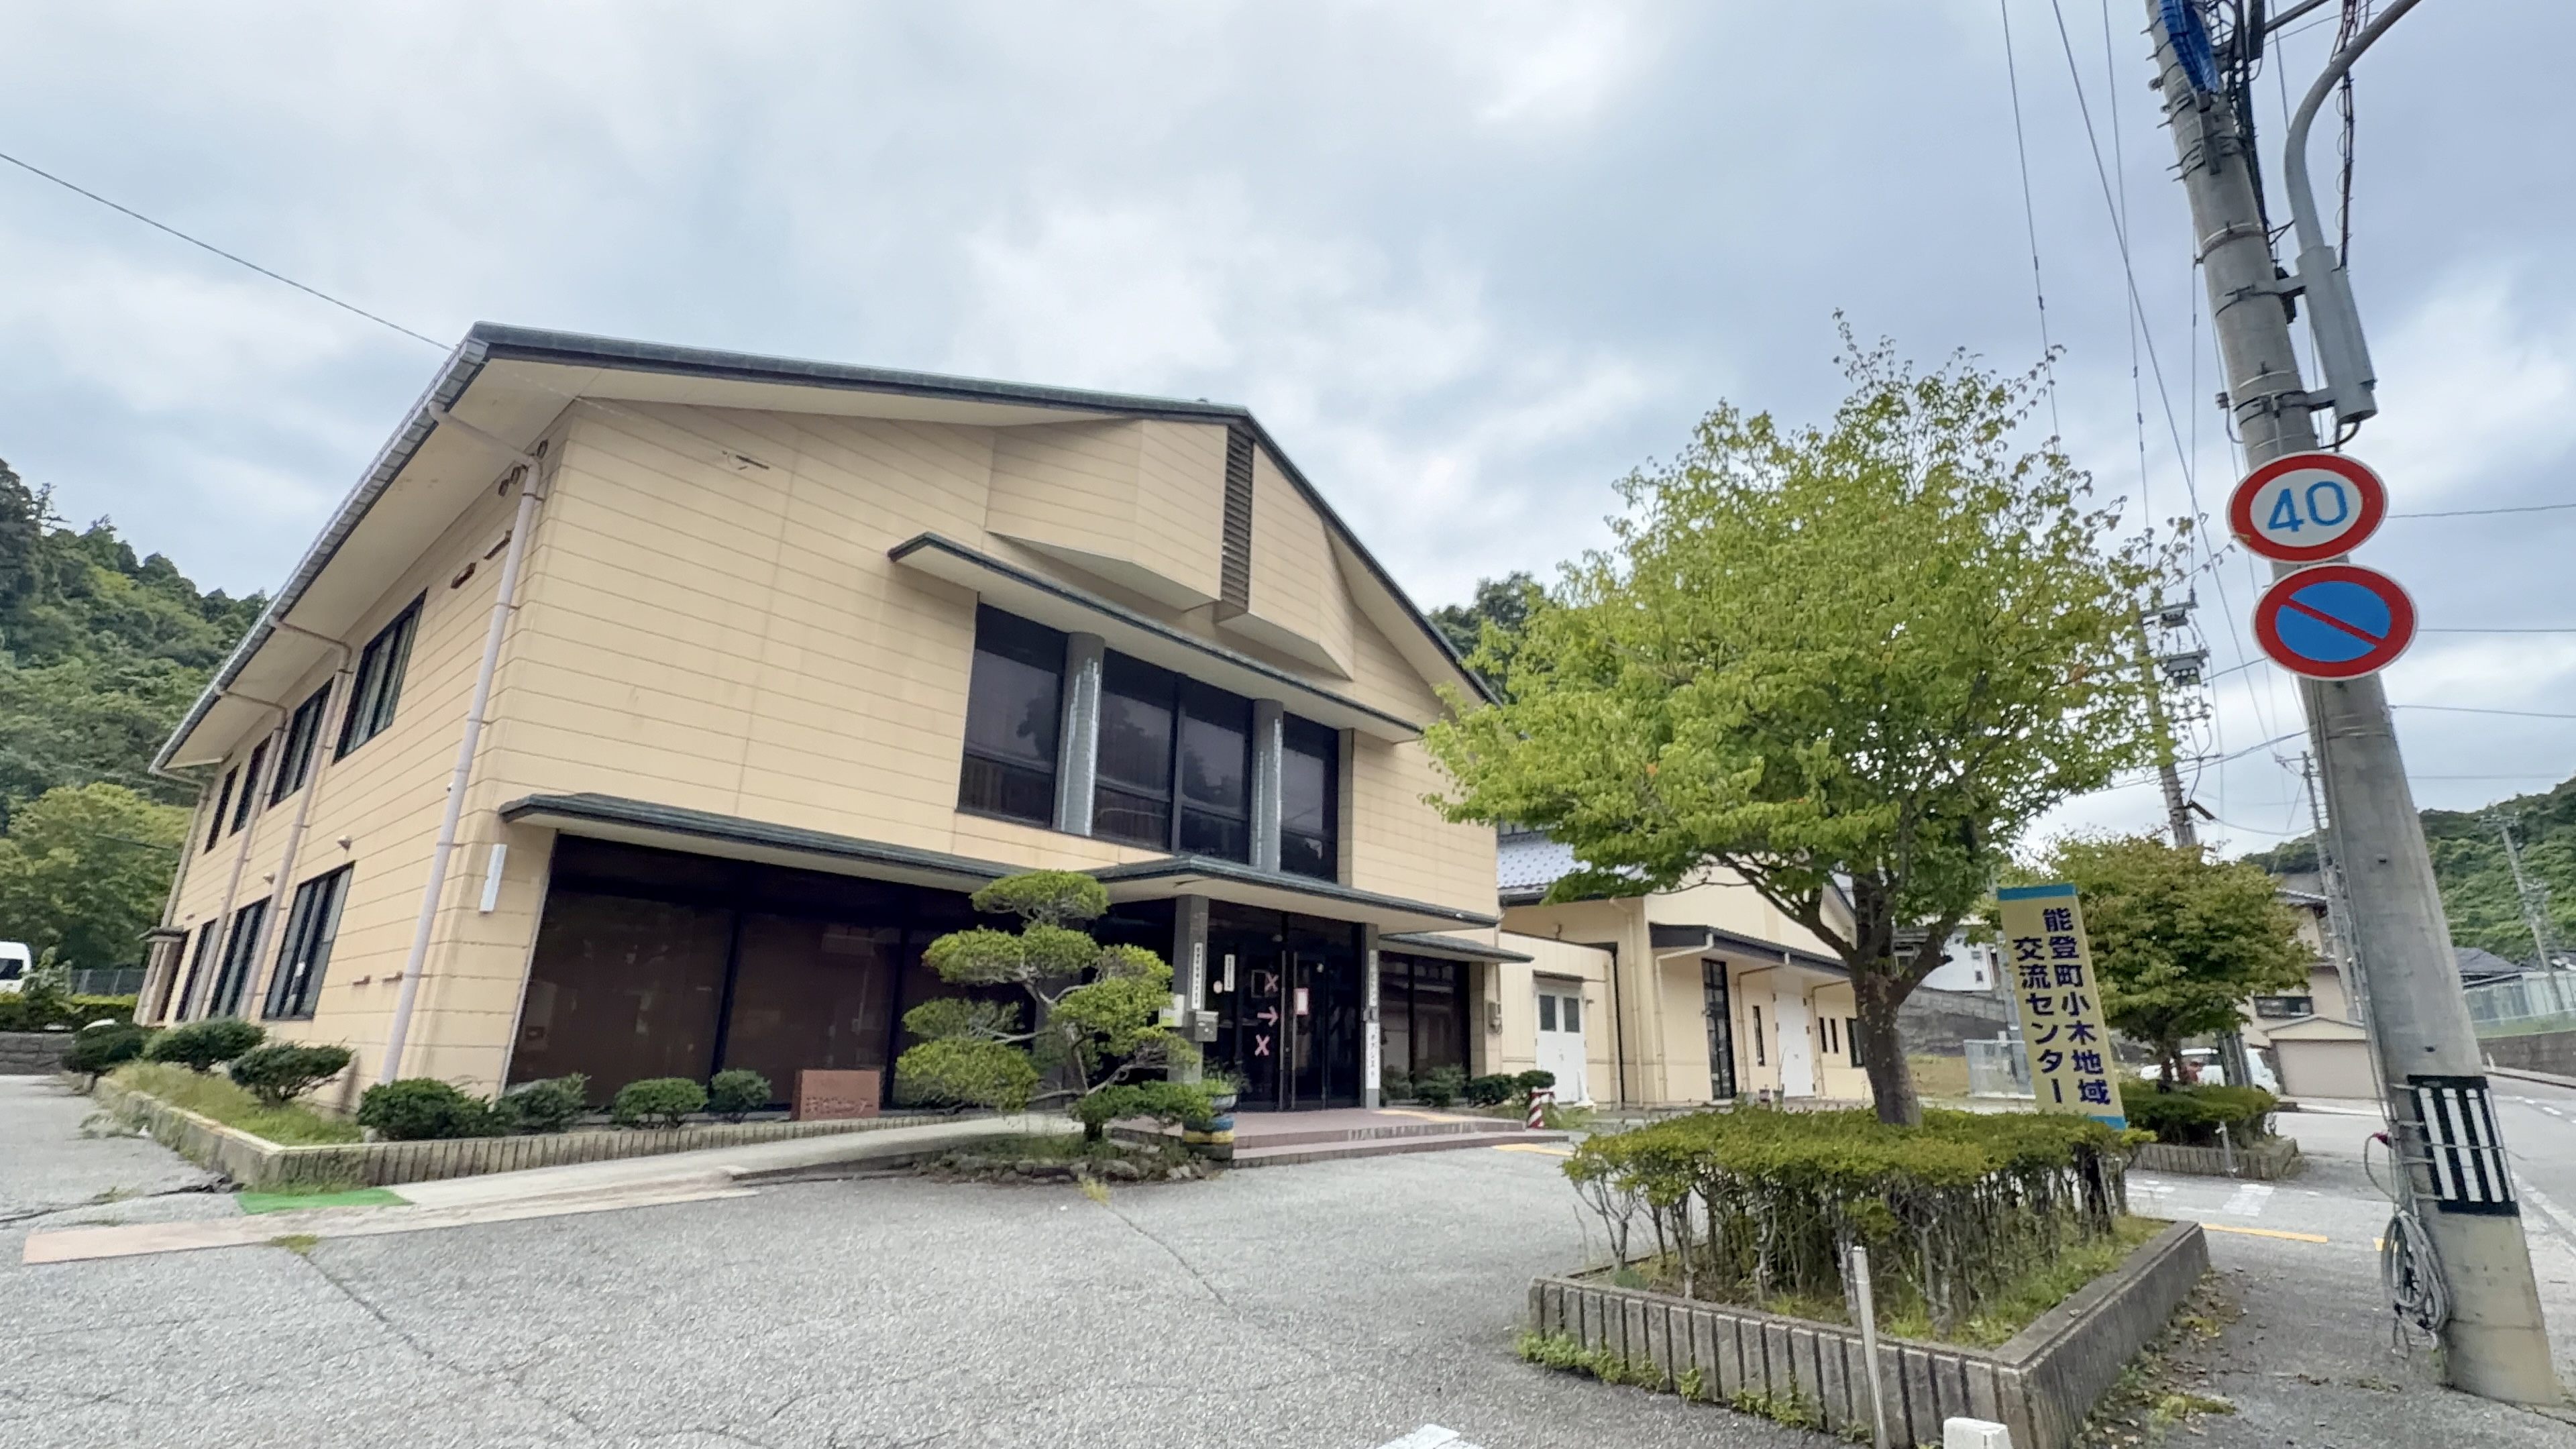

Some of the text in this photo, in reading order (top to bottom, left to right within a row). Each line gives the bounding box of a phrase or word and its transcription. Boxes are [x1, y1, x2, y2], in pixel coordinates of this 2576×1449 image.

[2267, 481, 2349, 532] 40
[2012, 936, 2063, 1104] 交流センター
[2042, 907, 2111, 1106] 能登町小木地域
